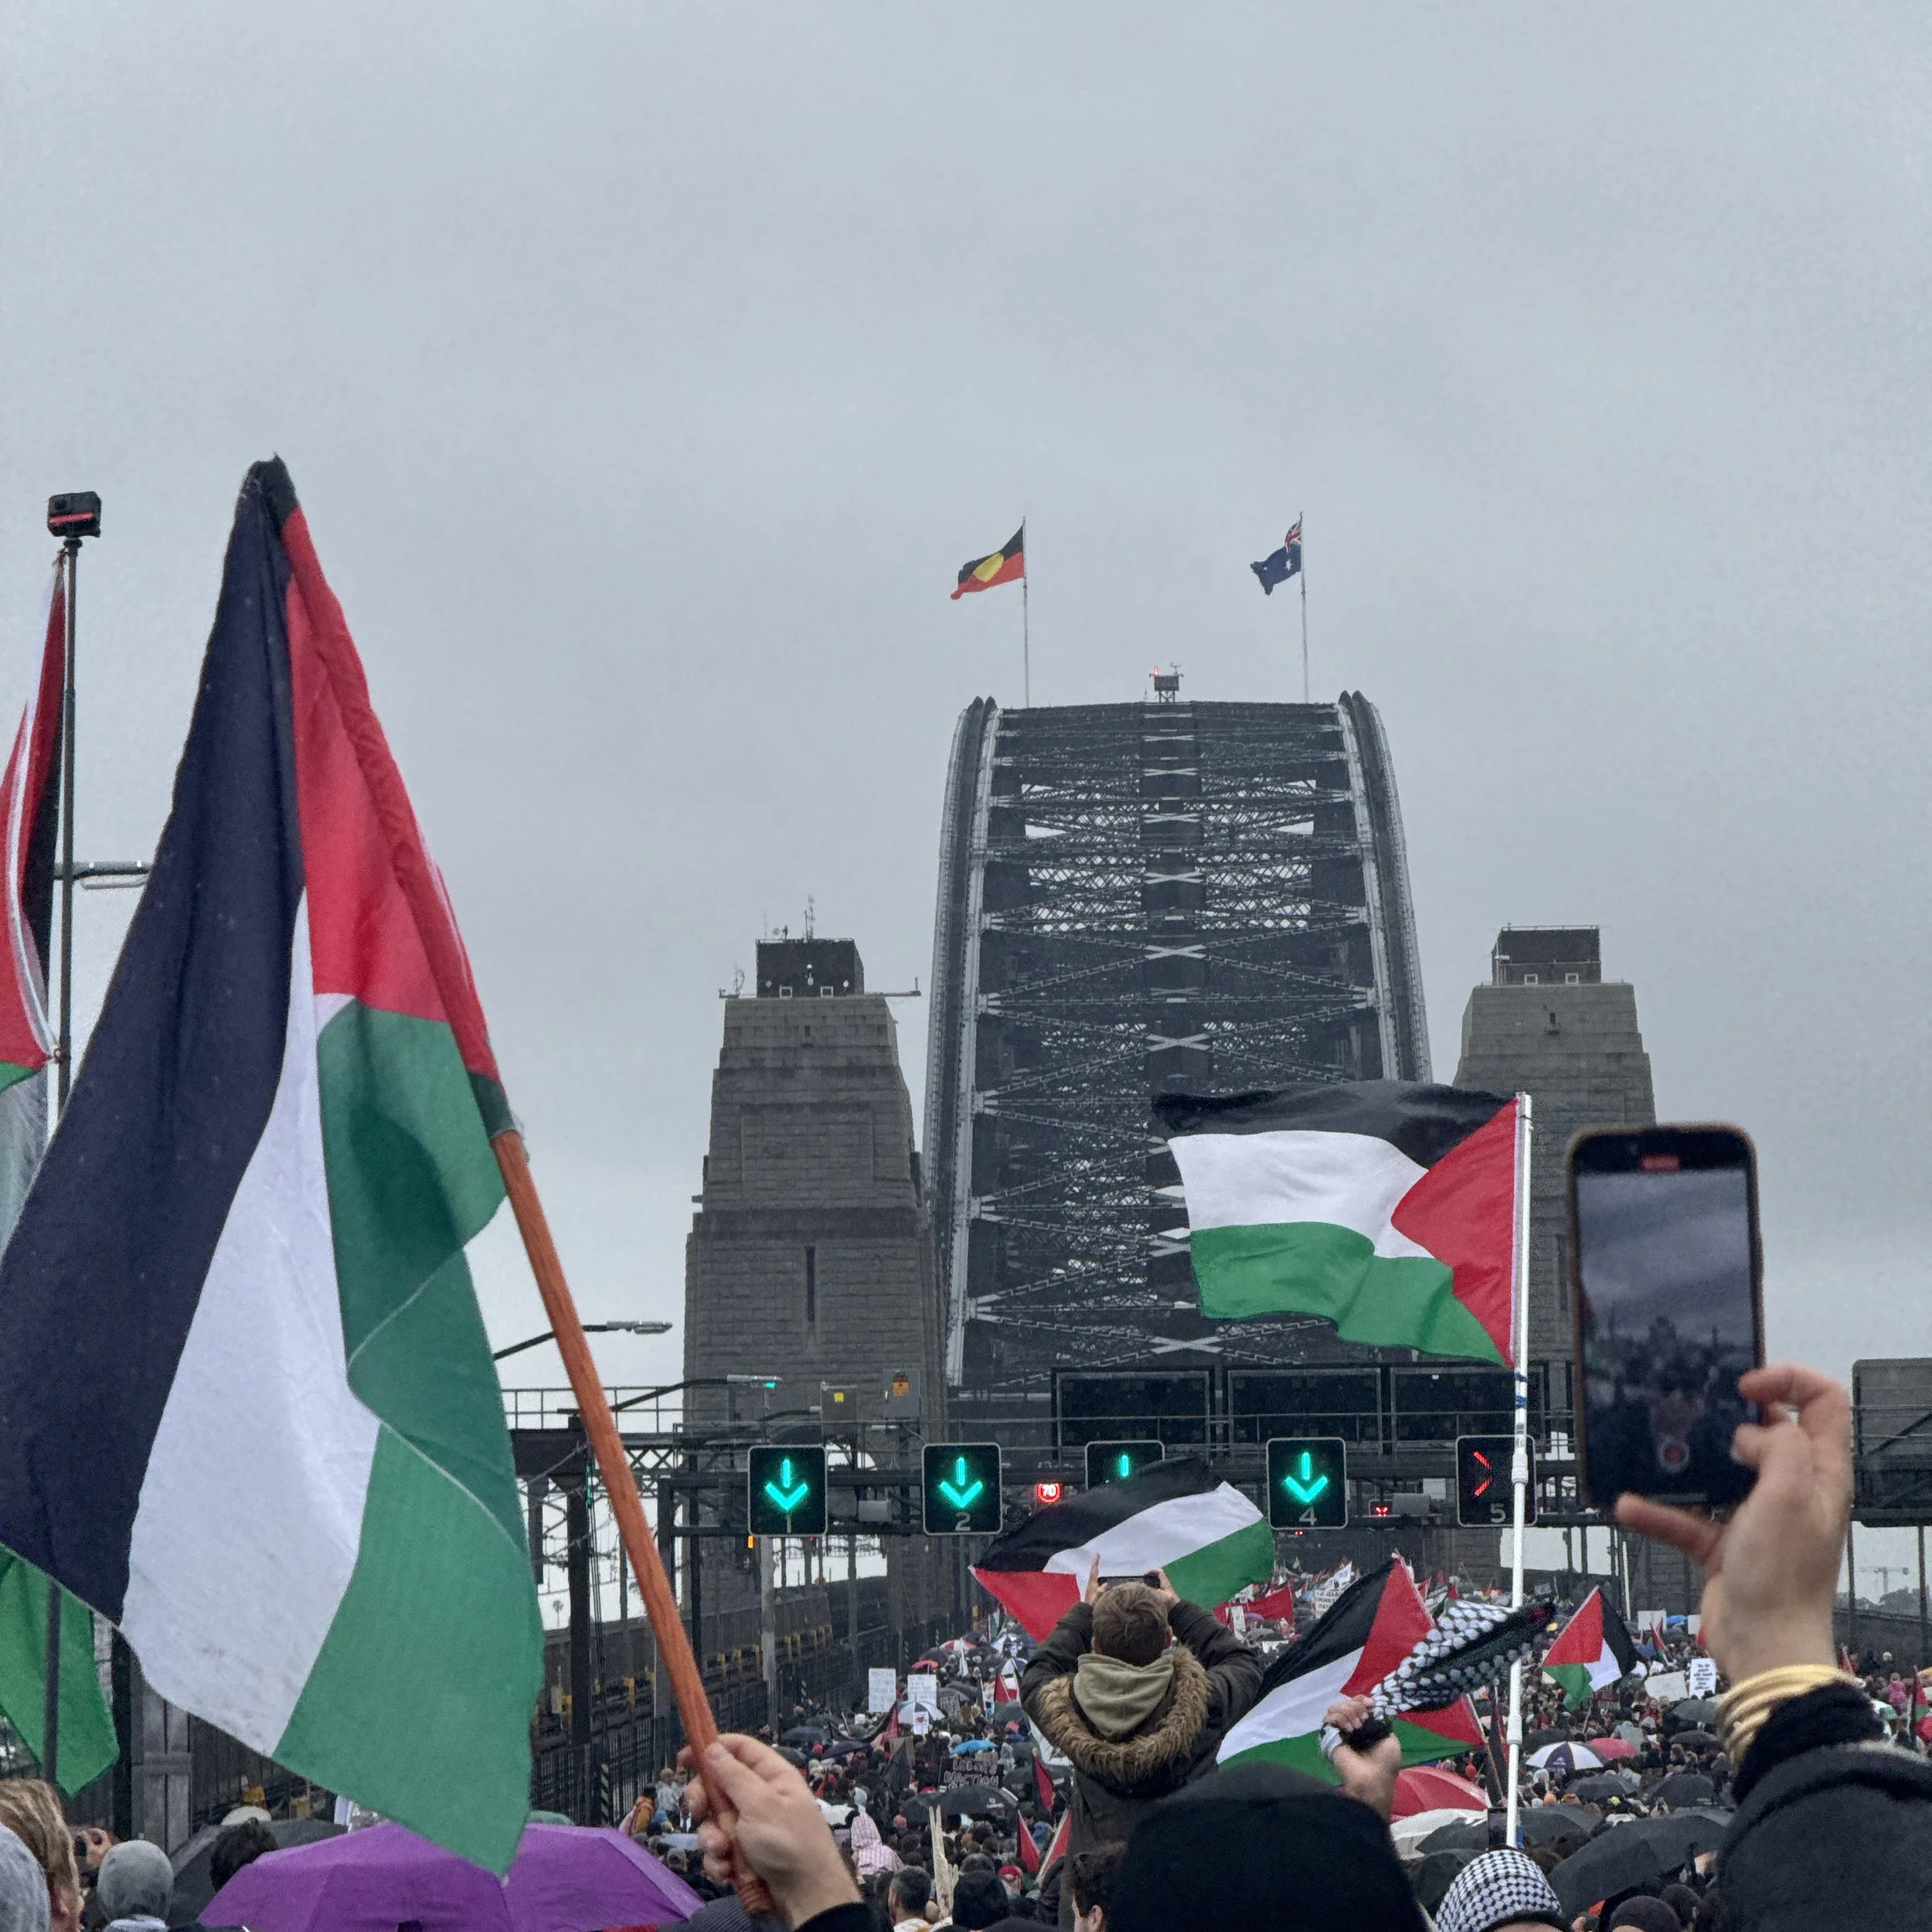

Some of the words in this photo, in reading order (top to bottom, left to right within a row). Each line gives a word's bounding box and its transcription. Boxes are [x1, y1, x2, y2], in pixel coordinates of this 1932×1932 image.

[1043, 1483, 1056, 1497] 70
[955, 1512, 971, 1532] 2
[1298, 1506, 1318, 1526] 4
[1491, 1502, 1506, 1523] 5
[784, 1513, 792, 1534] 1
[944, 1770, 999, 1787] INACTION
